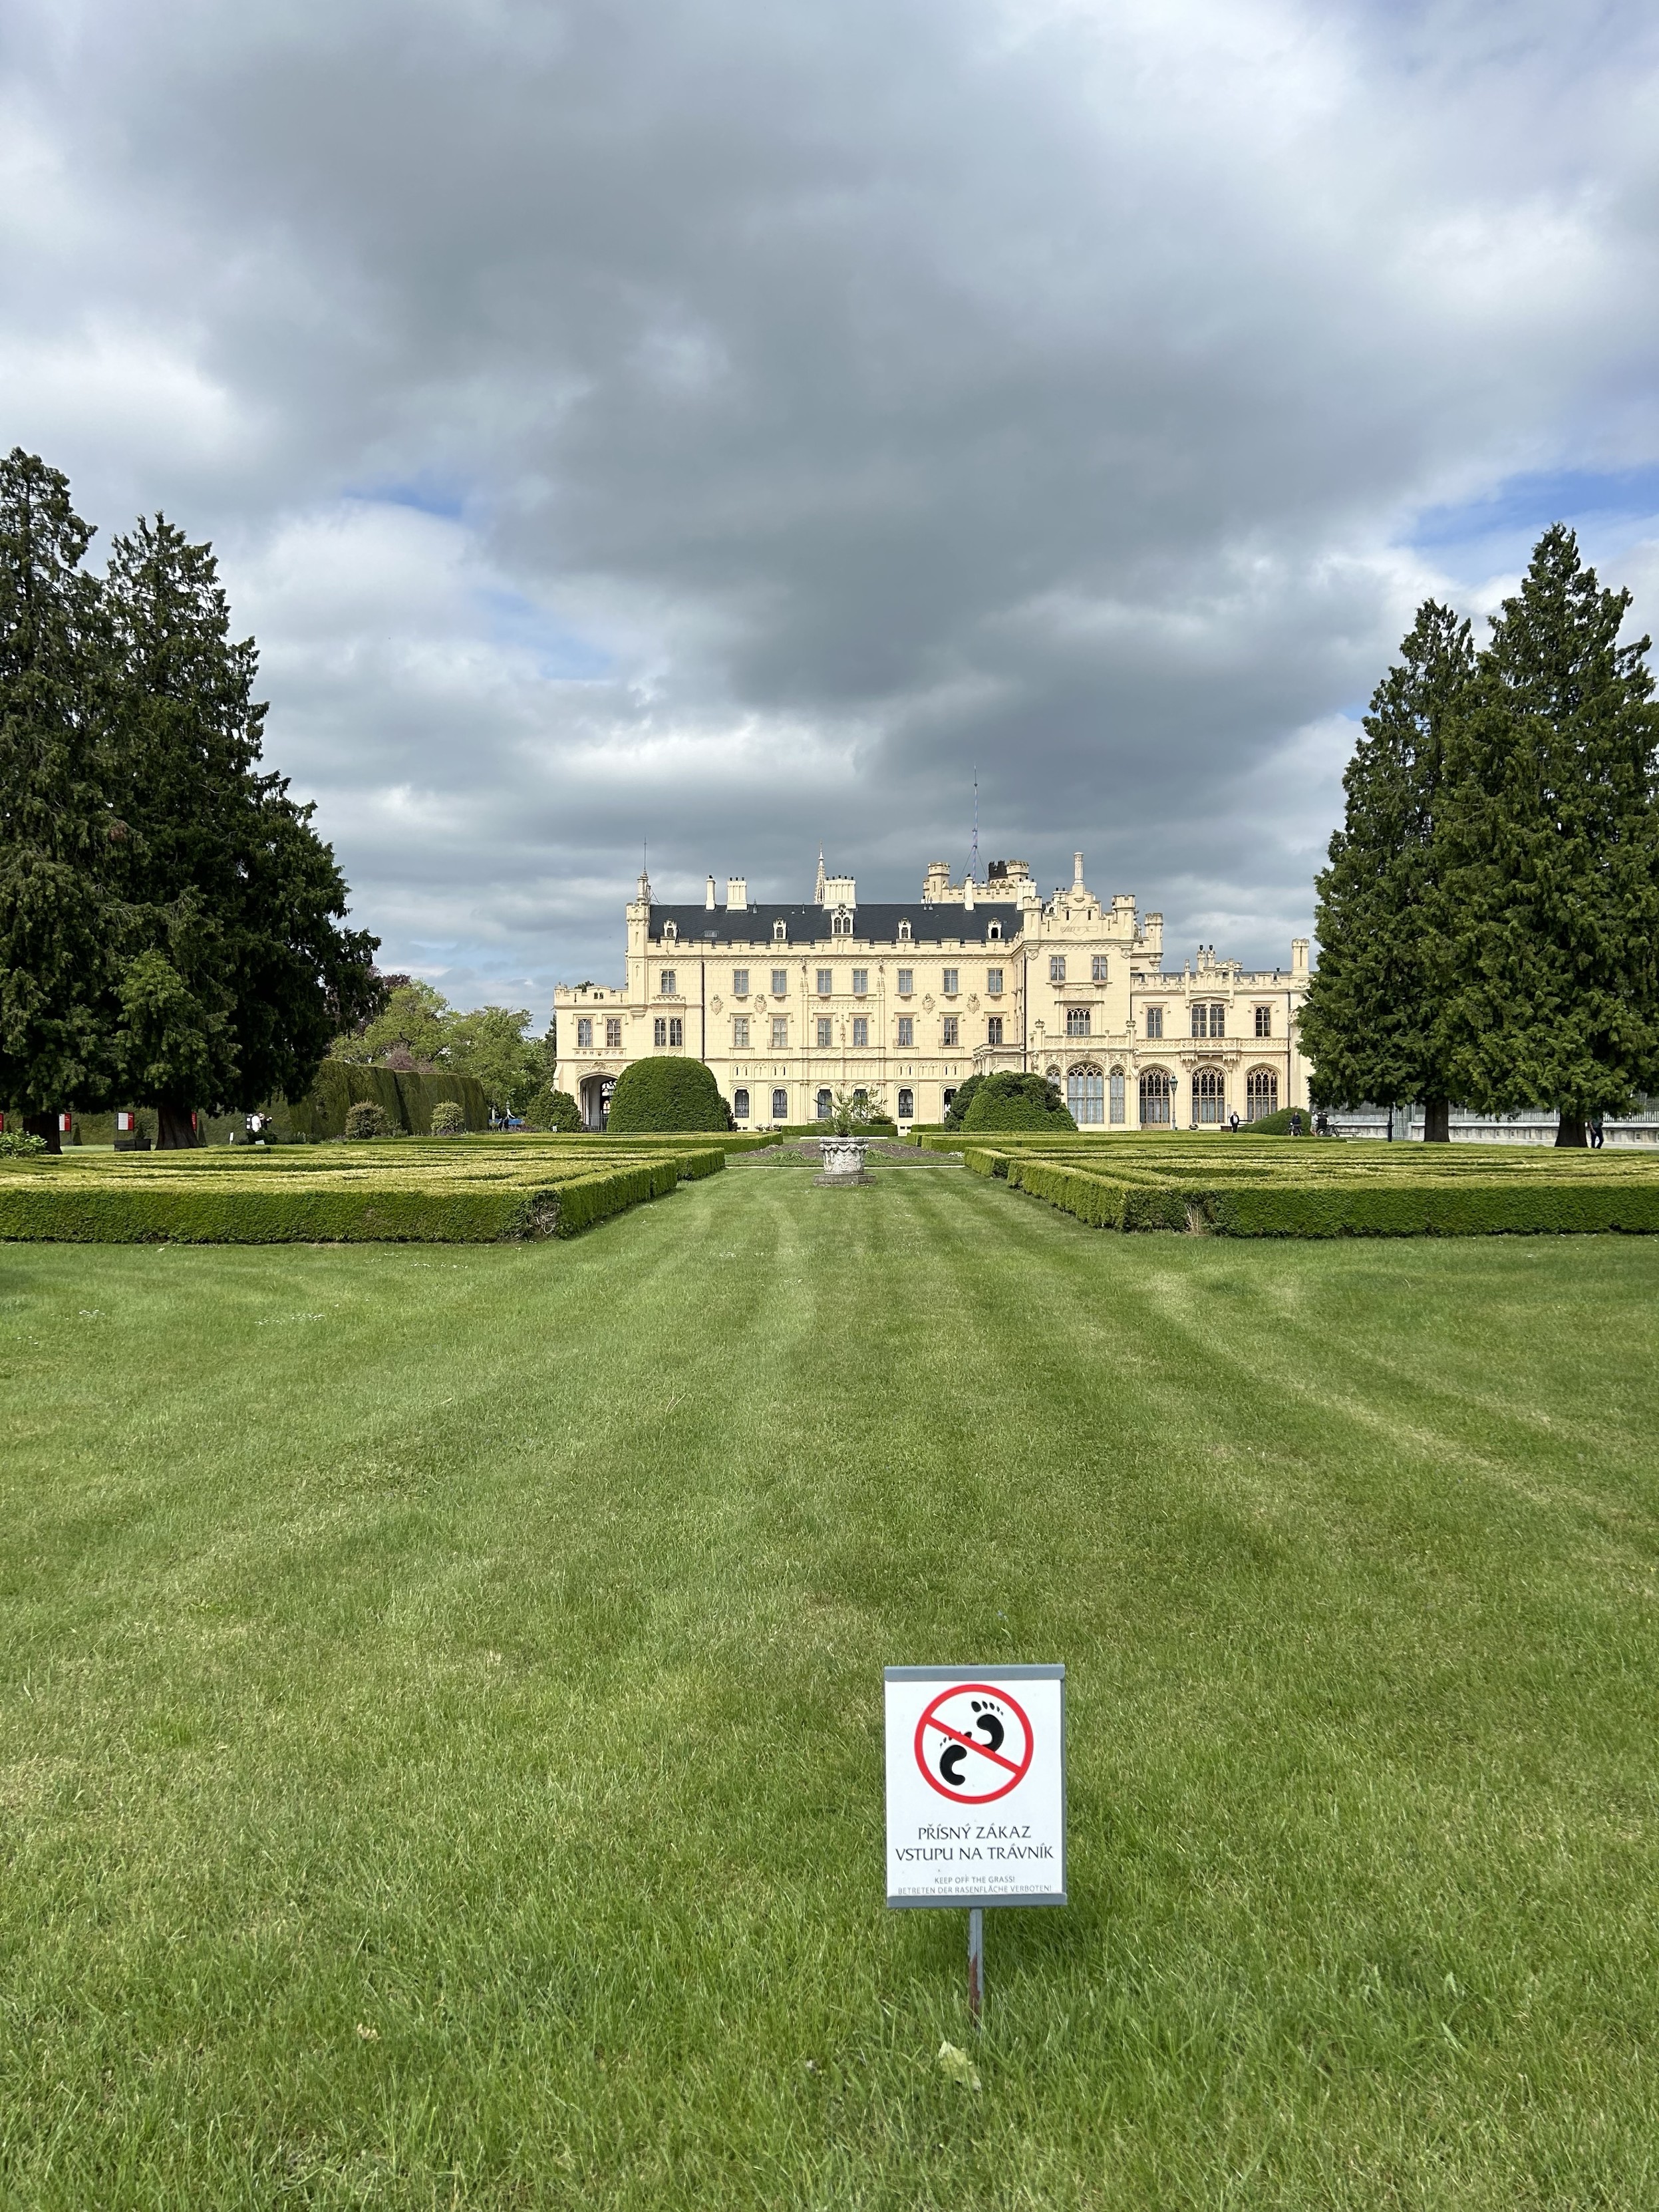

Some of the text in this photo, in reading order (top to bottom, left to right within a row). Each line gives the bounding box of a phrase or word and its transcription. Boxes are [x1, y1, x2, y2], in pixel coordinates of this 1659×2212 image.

[918, 1822, 1032, 1840] PŘÍSNÝ ZÁKAZ
[895, 1842, 1054, 1861] VSTUPU NA TRÁVNÍK
[955, 1885, 1008, 1893] RASENFLÄCHE
